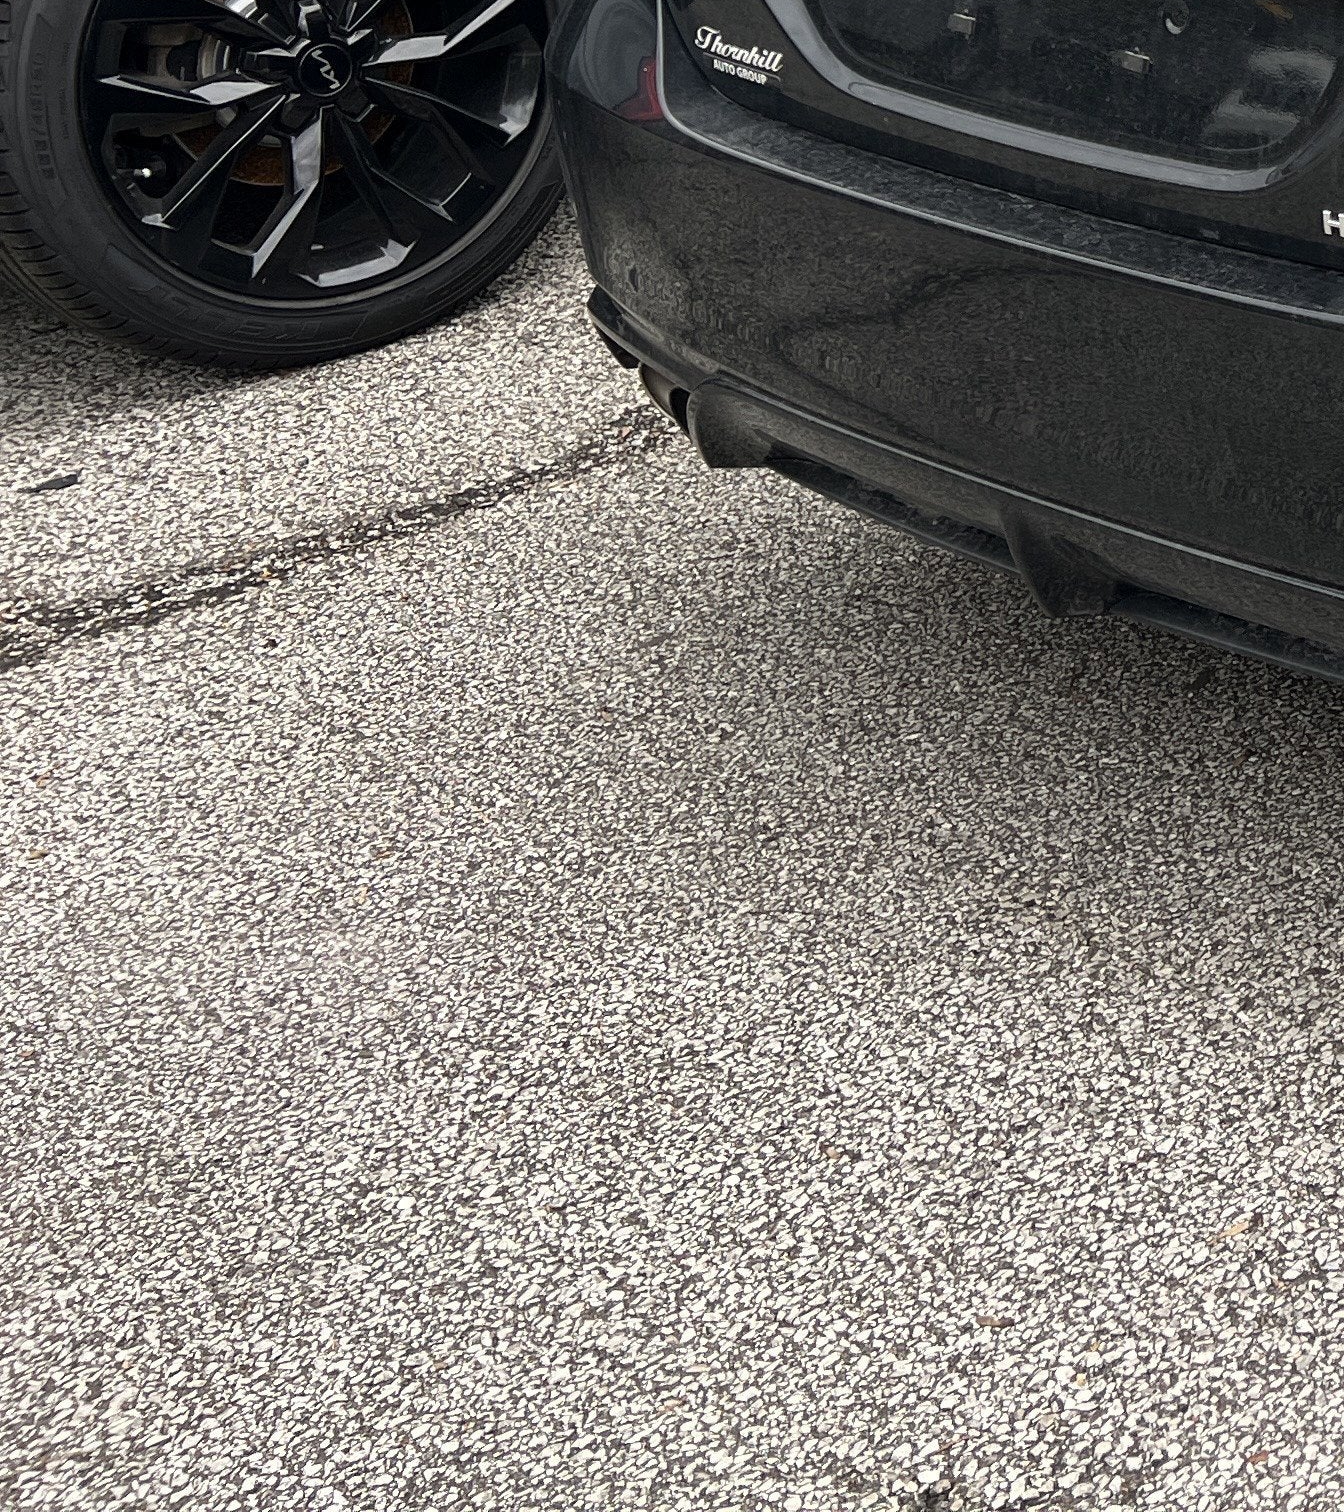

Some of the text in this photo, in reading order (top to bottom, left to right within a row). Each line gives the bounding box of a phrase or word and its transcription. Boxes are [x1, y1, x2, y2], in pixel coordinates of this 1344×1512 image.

[694, 25, 784, 72] Thornhill
[713, 58, 768, 85] AUTO GROUP
